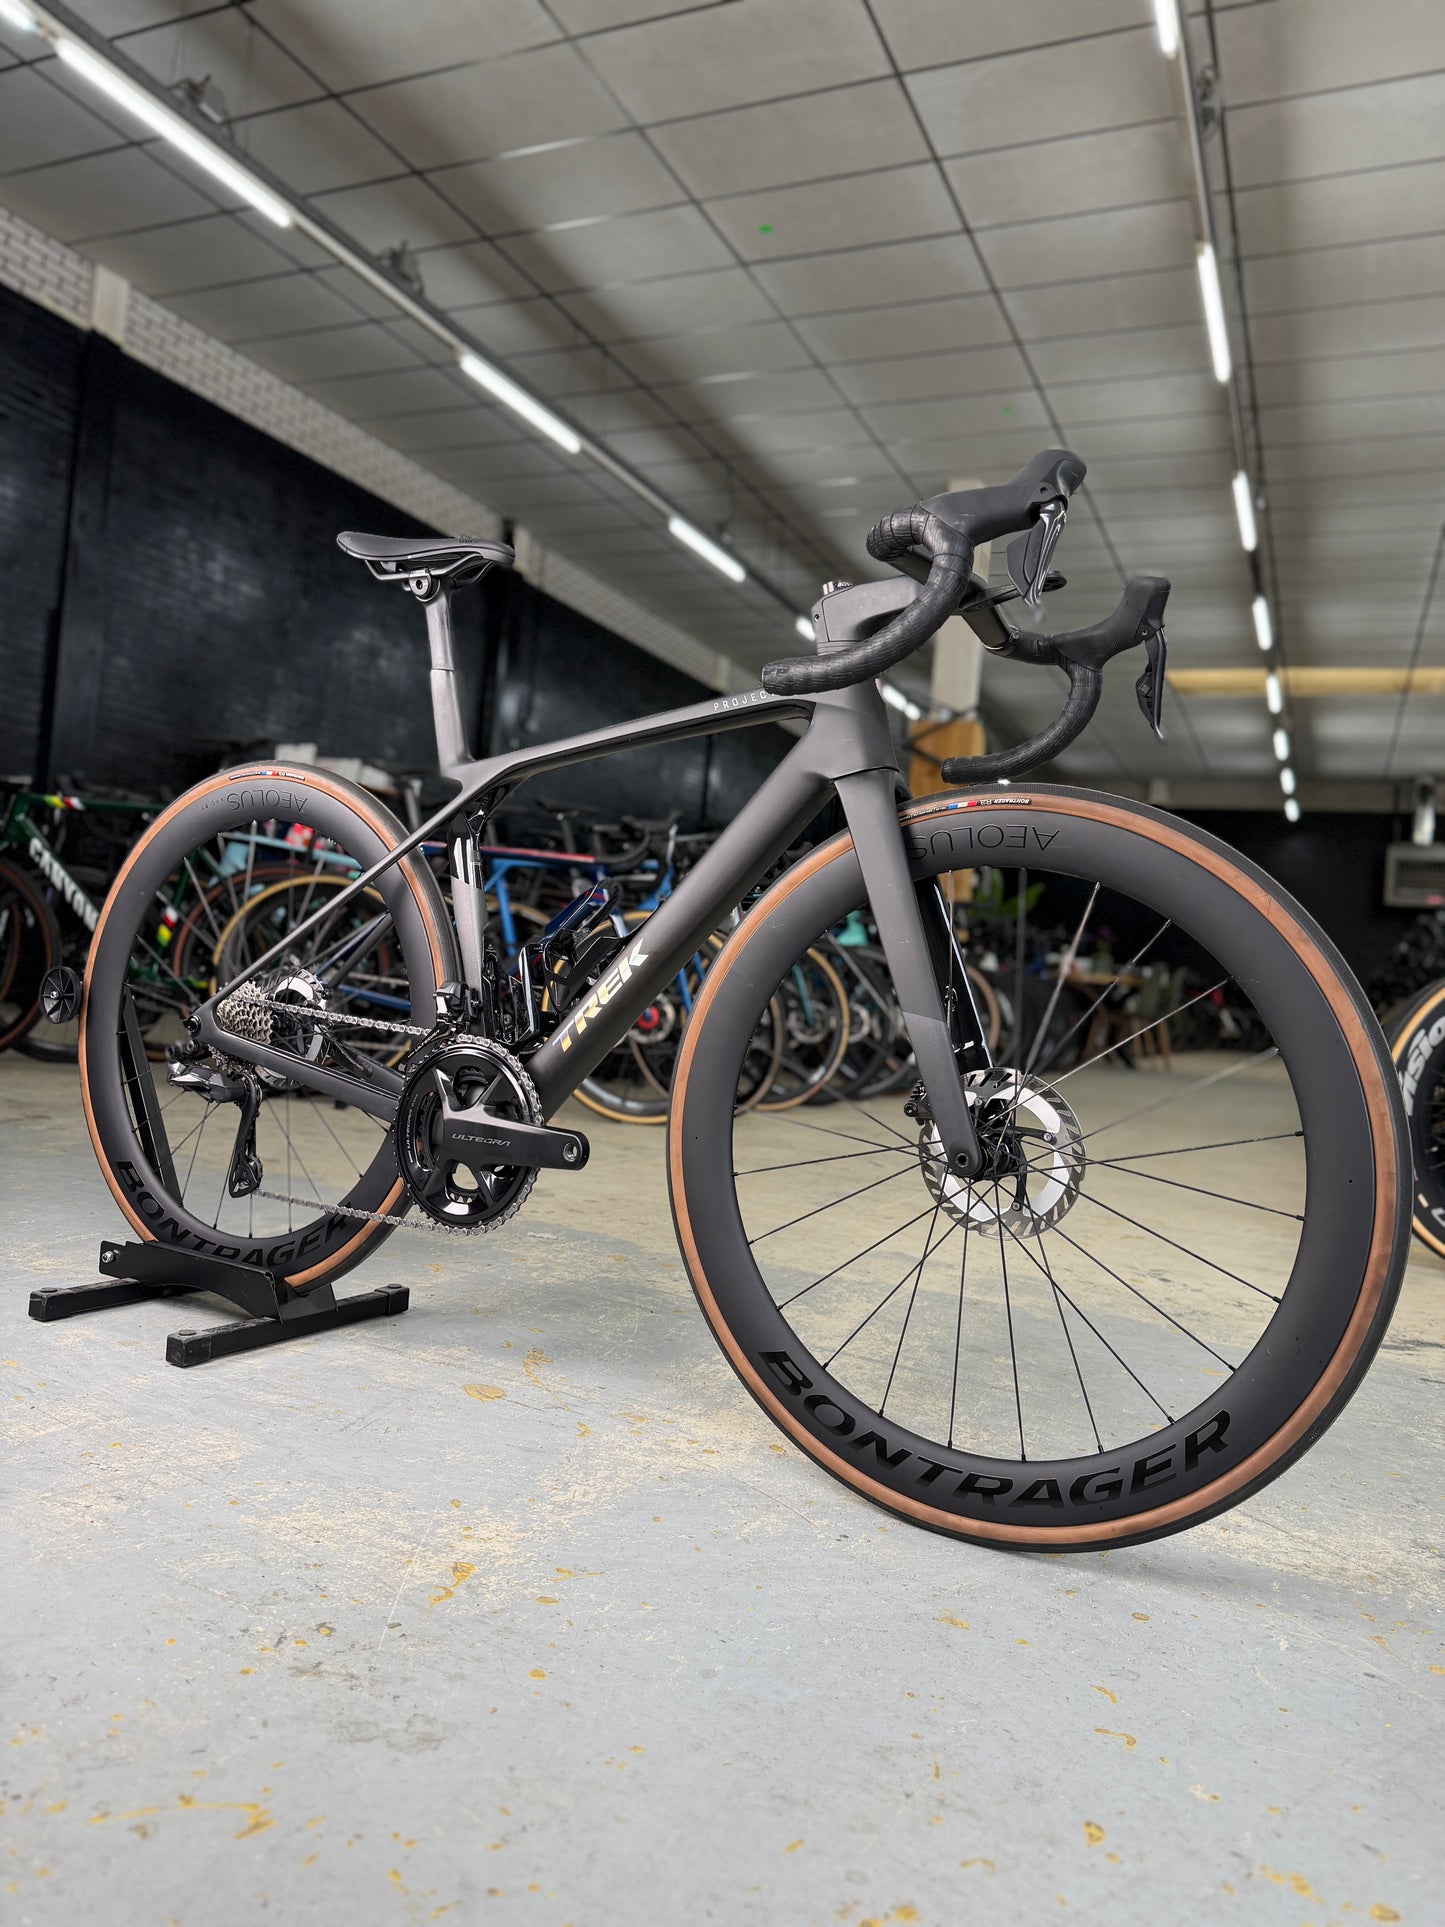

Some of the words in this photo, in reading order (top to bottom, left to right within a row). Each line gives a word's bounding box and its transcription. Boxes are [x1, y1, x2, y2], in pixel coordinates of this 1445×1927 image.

[713, 690, 775, 711] PROJEC
[227, 789, 308, 812] AEOLUS
[905, 823, 1060, 860] AEOLUS
[29, 837, 101, 932] CANYON
[552, 938, 649, 1052] TREK
[452, 1133, 511, 1147] ULTEGRA
[758, 1350, 1231, 1508] BONTRAGER
